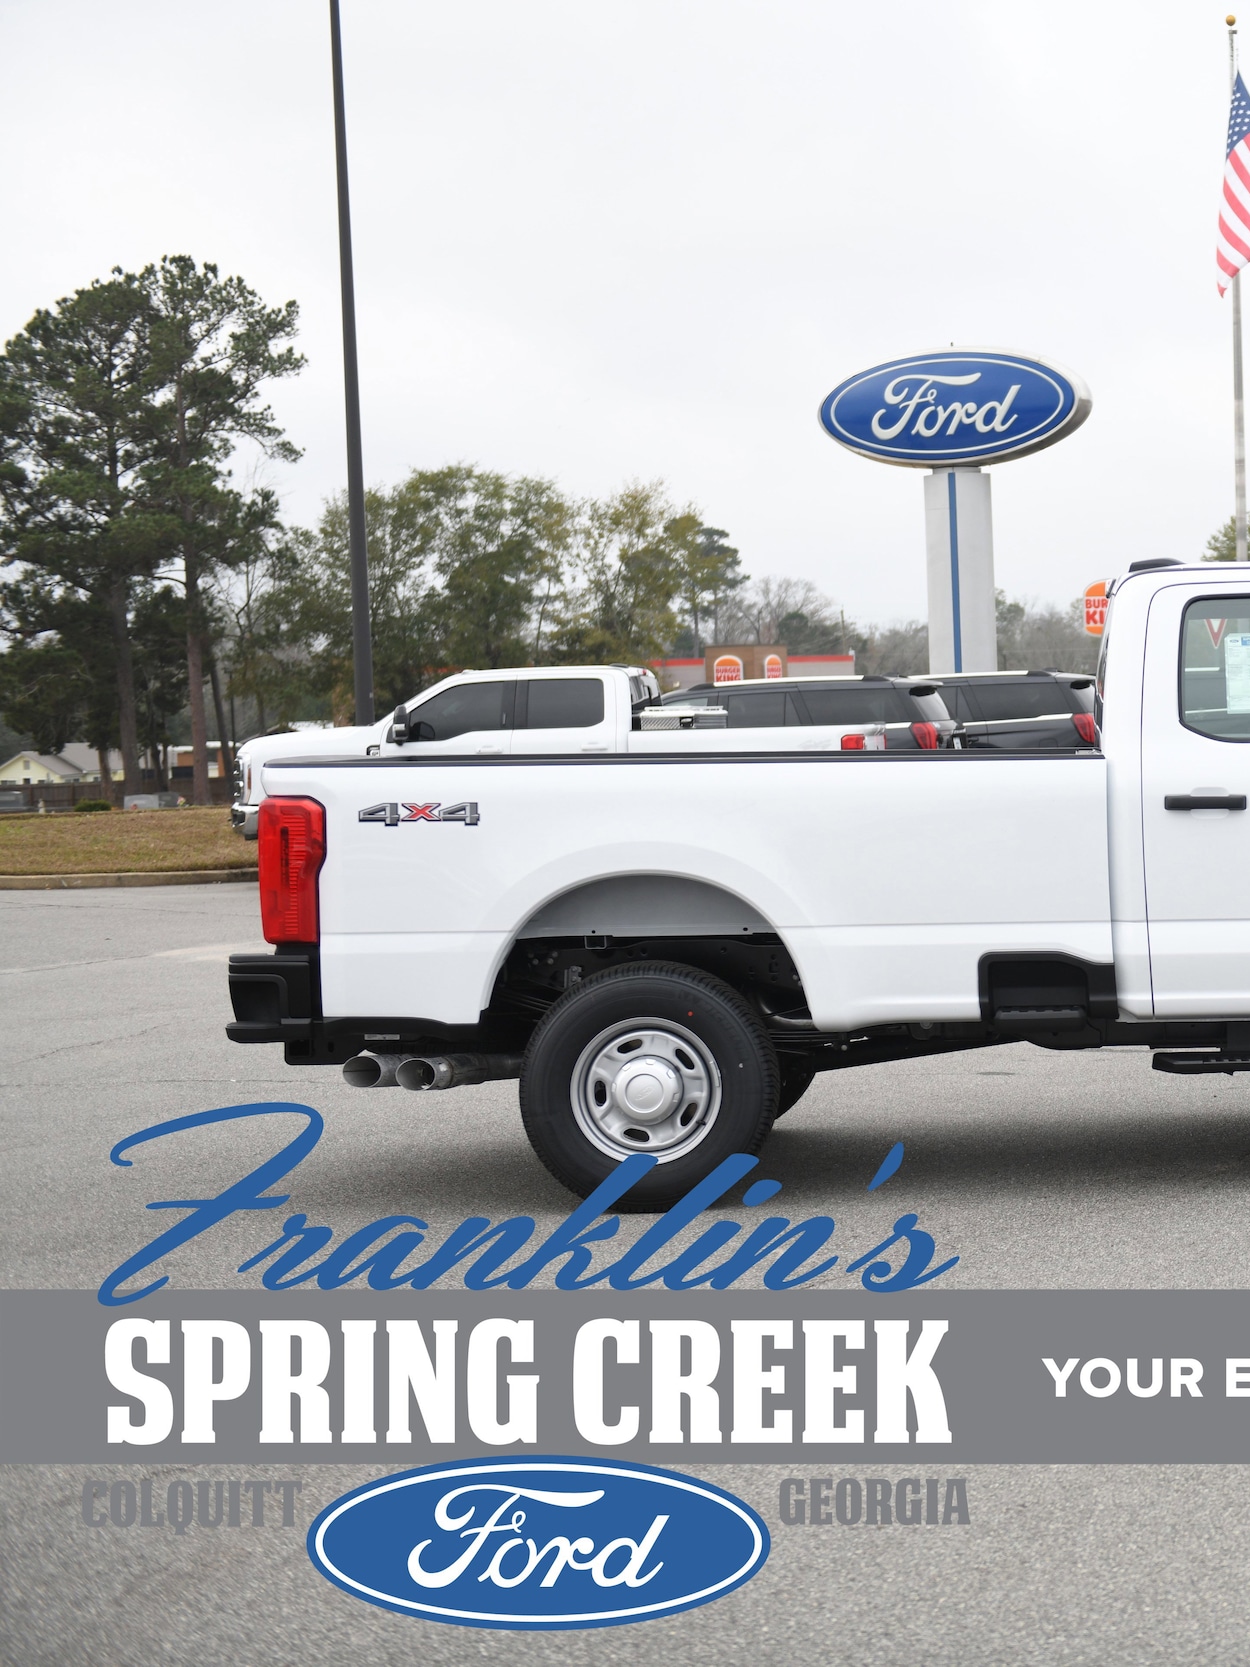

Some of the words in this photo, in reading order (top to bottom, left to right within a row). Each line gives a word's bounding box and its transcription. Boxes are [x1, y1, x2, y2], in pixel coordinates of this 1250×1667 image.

[871, 372, 1022, 441] Ford
[1085, 598, 1108, 609] BUR
[1086, 610, 1105, 625] KI
